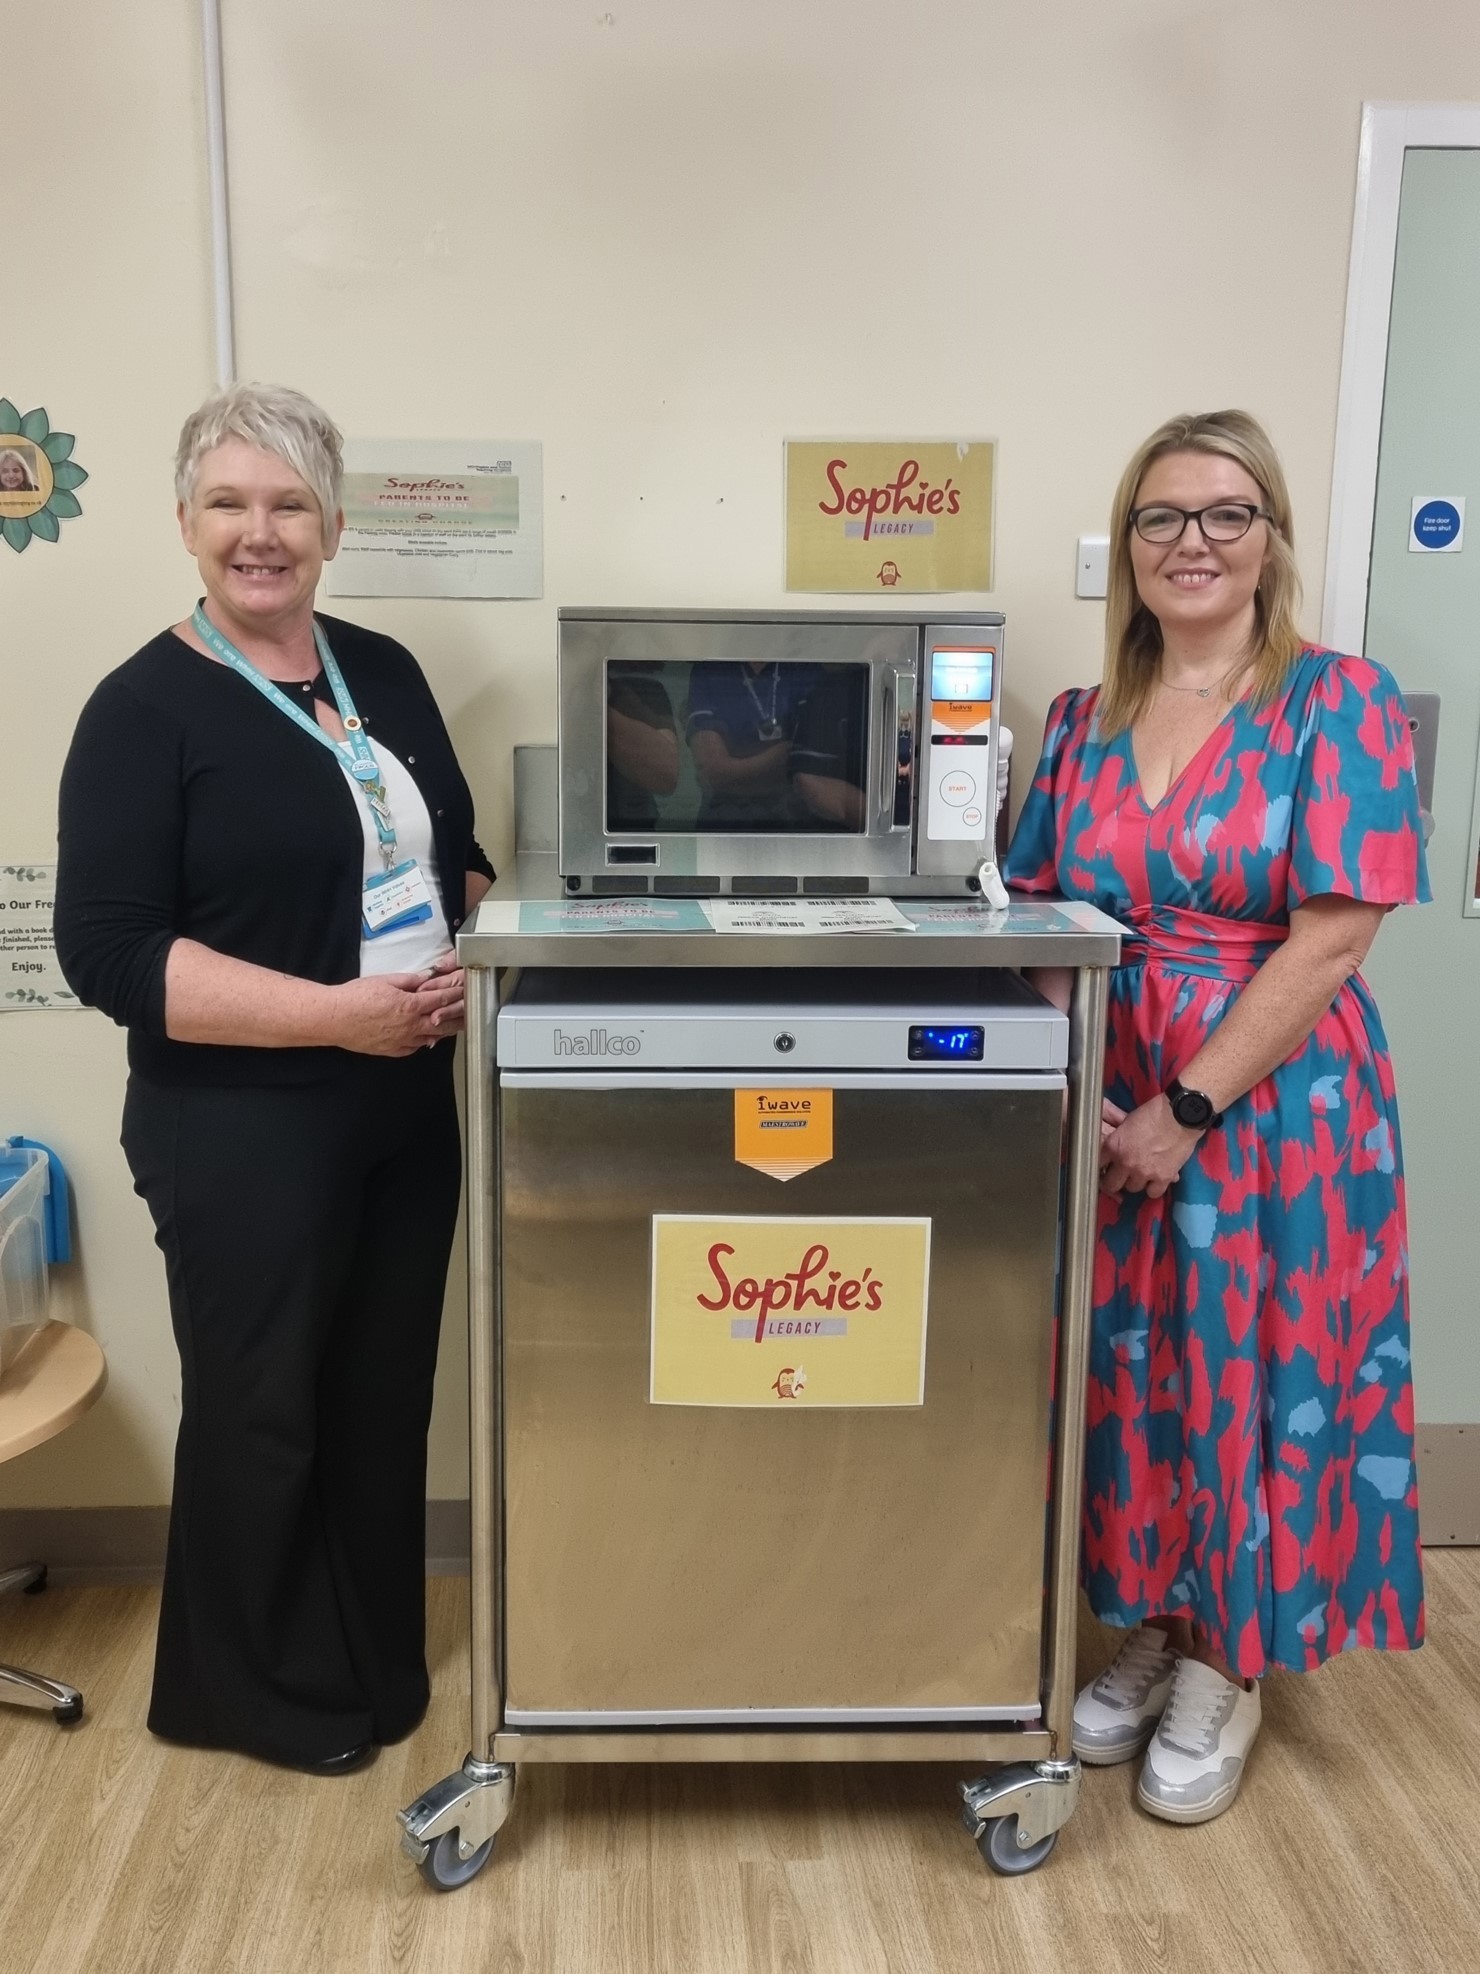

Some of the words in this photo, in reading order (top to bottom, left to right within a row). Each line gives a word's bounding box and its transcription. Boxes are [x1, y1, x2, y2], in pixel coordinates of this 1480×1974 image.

[384, 478, 465, 492] Sophie's
[818, 459, 961, 541] Sophie's
[873, 523, 914, 534] LEGACY
[10, 900, 31, 910] Our
[35, 899, 55, 909] Fre
[3, 936, 32, 944] finished,
[11, 961, 47, 973] Enjoy.
[553, 1028, 642, 1056] hallco
[756, 1095, 811, 1111] iwave
[697, 1242, 884, 1344] Sophie's
[768, 1321, 823, 1335] LEGACY
